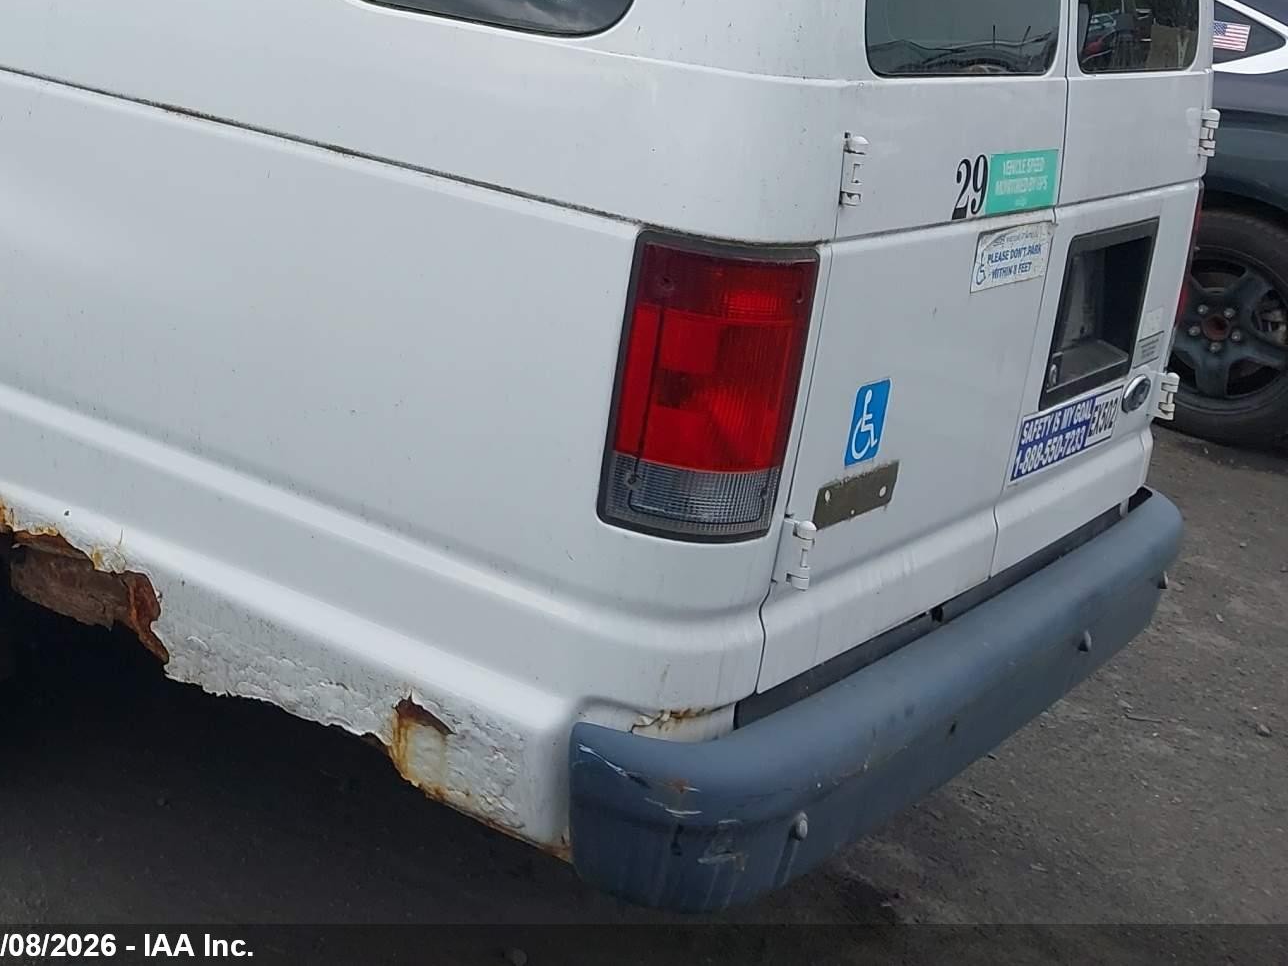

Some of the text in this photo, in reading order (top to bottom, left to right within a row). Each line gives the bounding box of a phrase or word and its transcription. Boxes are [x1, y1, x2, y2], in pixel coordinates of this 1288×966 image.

[952, 154, 989, 220] 29
[987, 244, 1042, 264] PLEASE DON'T PARK
[992, 266, 1012, 279] WITHIN
[1018, 262, 1033, 273] FEET
[1021, 399, 1093, 445] SAFETY IS MY GOAL
[1014, 425, 1087, 478] 1-888-550-7233
